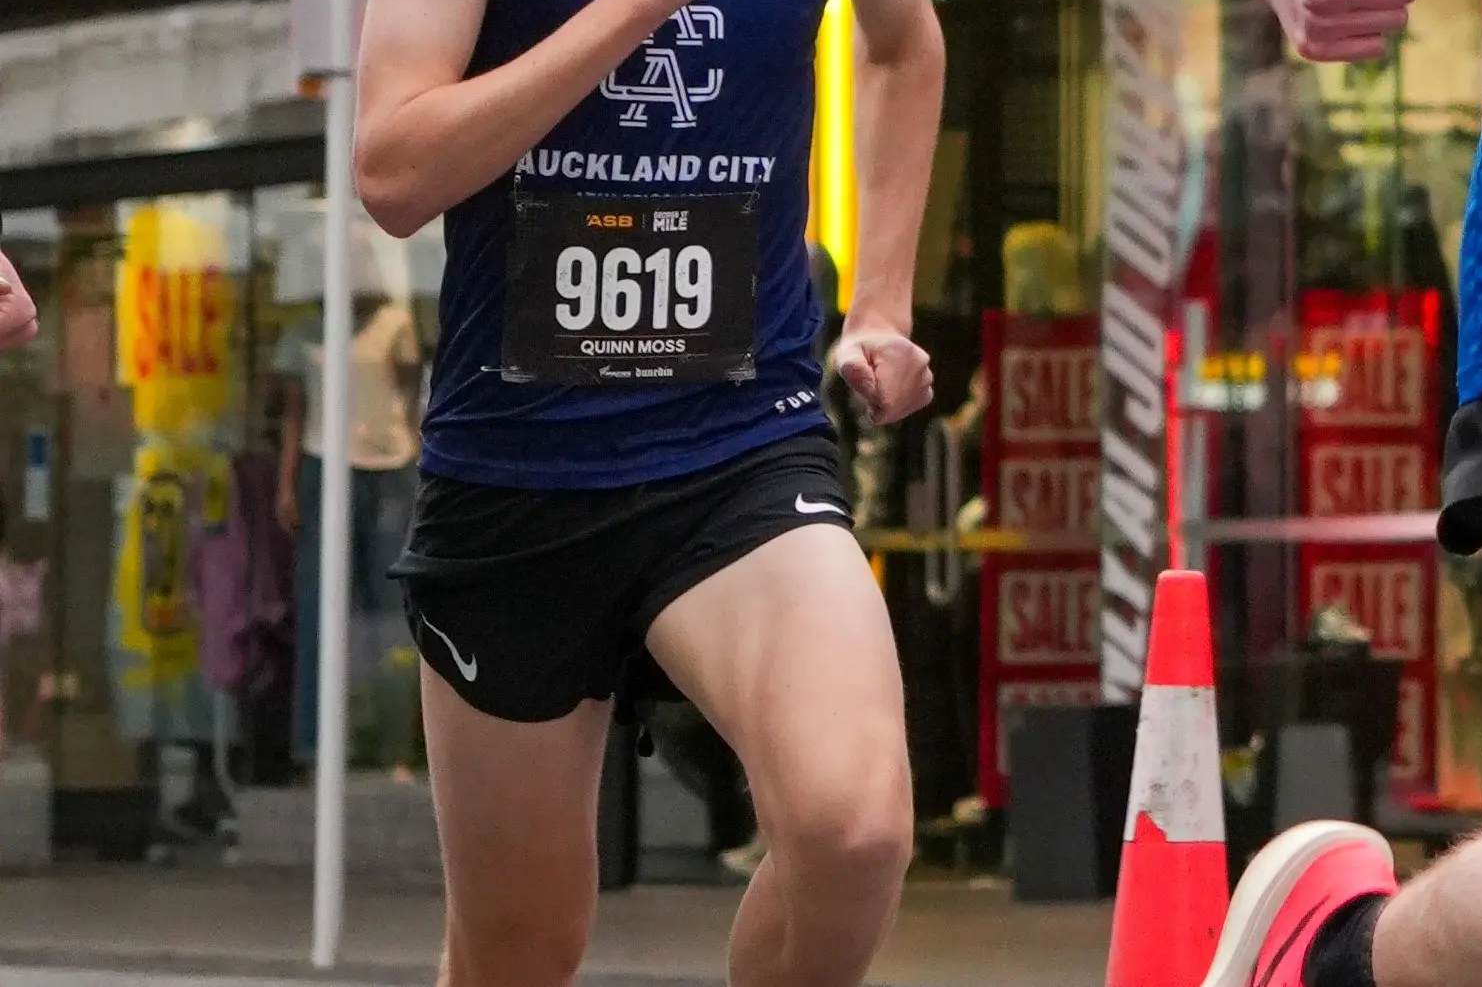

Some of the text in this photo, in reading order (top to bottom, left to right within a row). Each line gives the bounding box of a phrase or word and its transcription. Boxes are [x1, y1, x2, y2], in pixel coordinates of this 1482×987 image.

[514, 149, 777, 184] AUCKLAND CITY
[586, 214, 633, 228] ASB
[652, 218, 688, 232] MILE
[555, 244, 713, 331] 9619
[580, 339, 686, 356] QUINN MOSS
[774, 390, 816, 414] SUB
